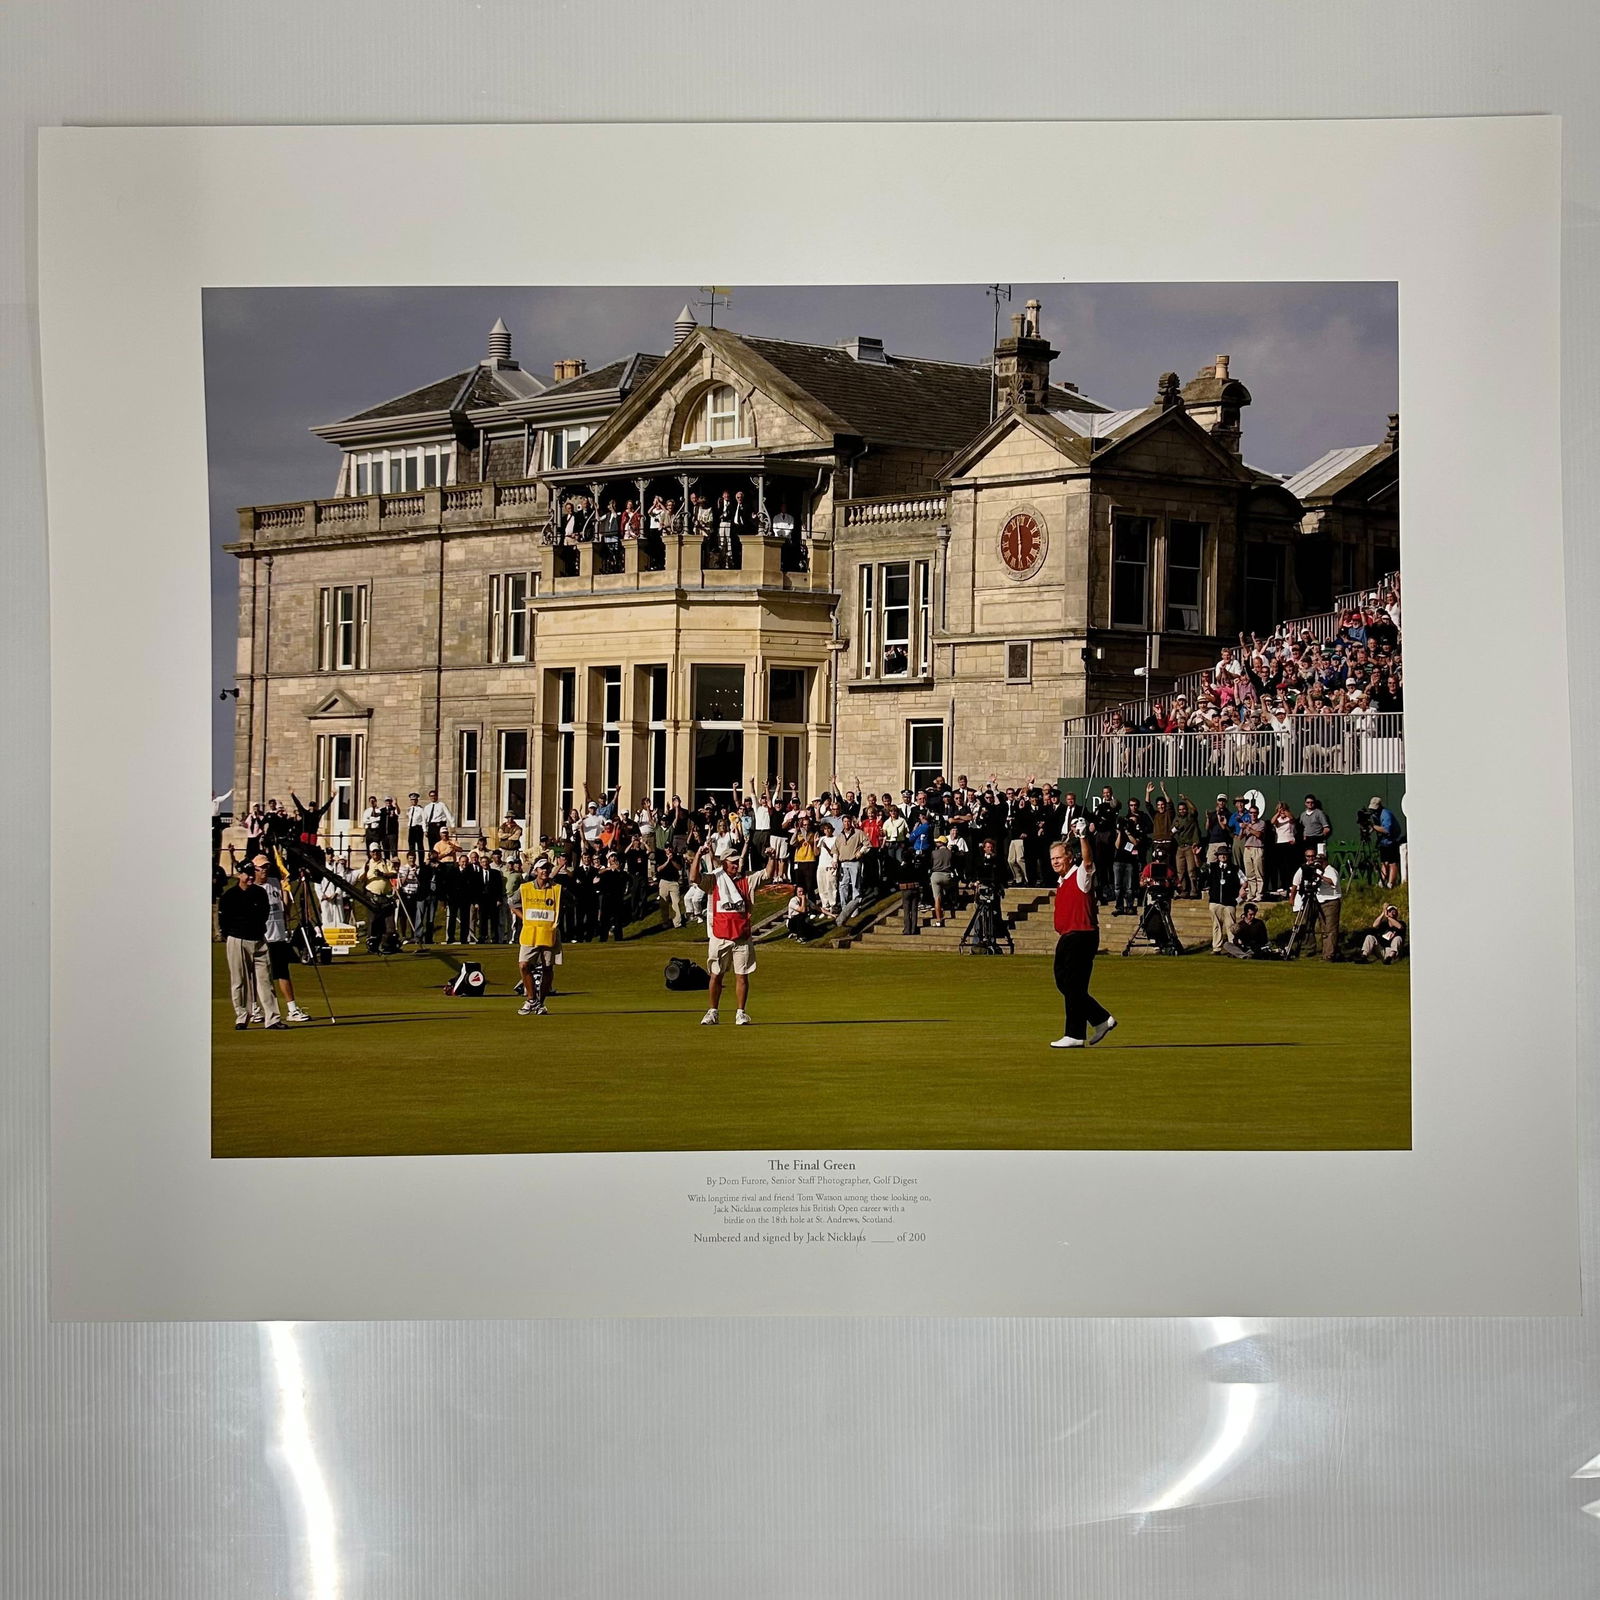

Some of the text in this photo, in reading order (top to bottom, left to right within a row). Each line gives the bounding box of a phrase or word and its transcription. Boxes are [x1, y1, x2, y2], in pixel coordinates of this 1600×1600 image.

[768, 1159, 856, 1171] The Final Green
[706, 1176, 918, 1188] By Dom Furore, Senior Staff Photographer, Golf Digest
[687, 1193, 932, 1204] With longtime rival and friend Tom Watson among those looking on,
[713, 1205, 729, 1215] Jack
[731, 1205, 762, 1213] Nicklaus
[763, 1205, 799, 1215] completes
[800, 1205, 811, 1213] his
[812, 1204, 837, 1213] British
[838, 1204, 859, 1214] Open
[882, 1204, 900, 1213] with
[723, 1216, 745, 1224] birdie
[757, 1216, 769, 1224] the
[771, 1216, 788, 1224] 18th
[789, 1216, 805, 1224] hole
[815, 1216, 825, 1224] St.
[826, 1216, 861, 1225] Andrews,
[861, 1216, 895, 1224] Scotland.
[693, 1231, 926, 1245] Numbered and signed by Jack Nicklaus of 200
